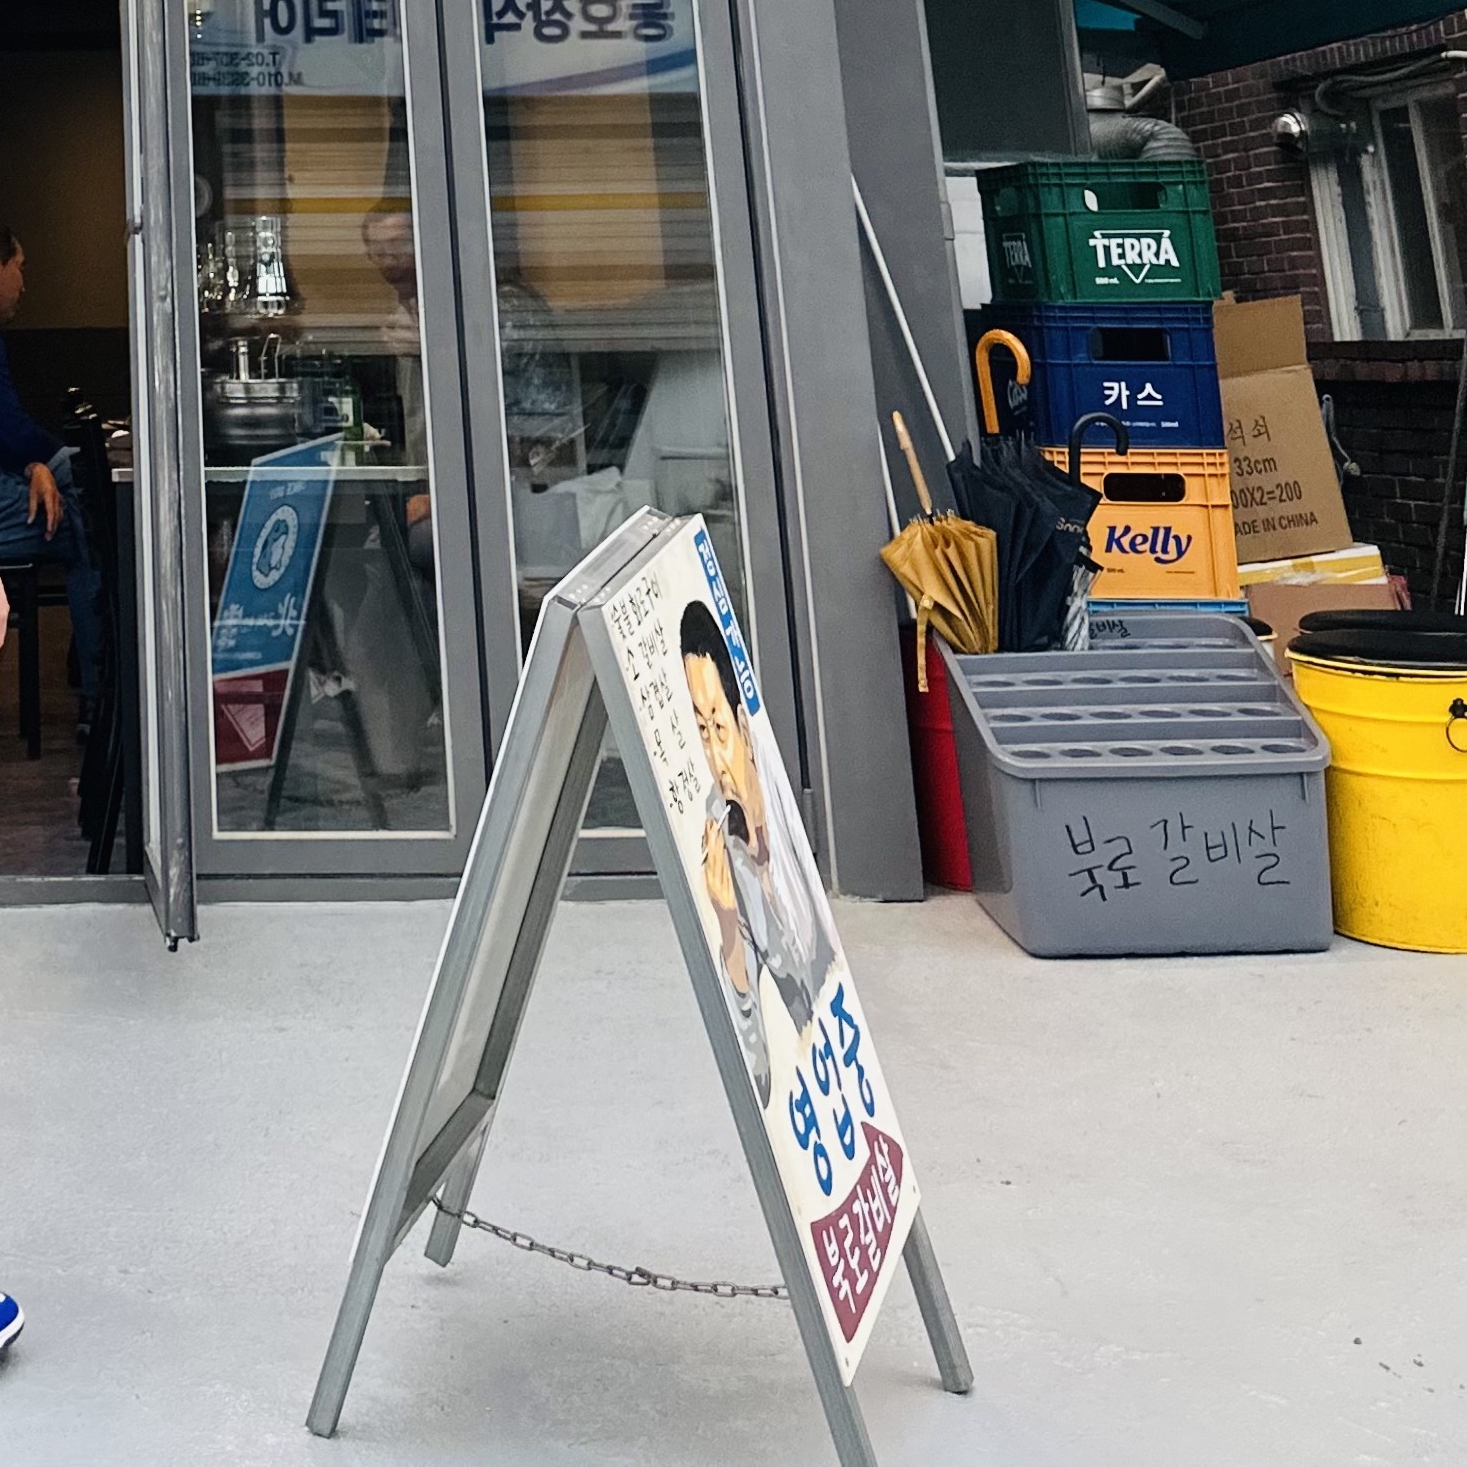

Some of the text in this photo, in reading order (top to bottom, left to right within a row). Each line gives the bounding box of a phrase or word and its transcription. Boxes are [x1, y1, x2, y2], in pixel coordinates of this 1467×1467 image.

[1089, 237, 1180, 268] TERRA
[1103, 381, 1164, 410] 카스
[1262, 517, 1276, 533] IN
[1278, 512, 1318, 530] CHINA
[1105, 524, 1193, 565] Kelly
[789, 982, 875, 1196] 영업중
